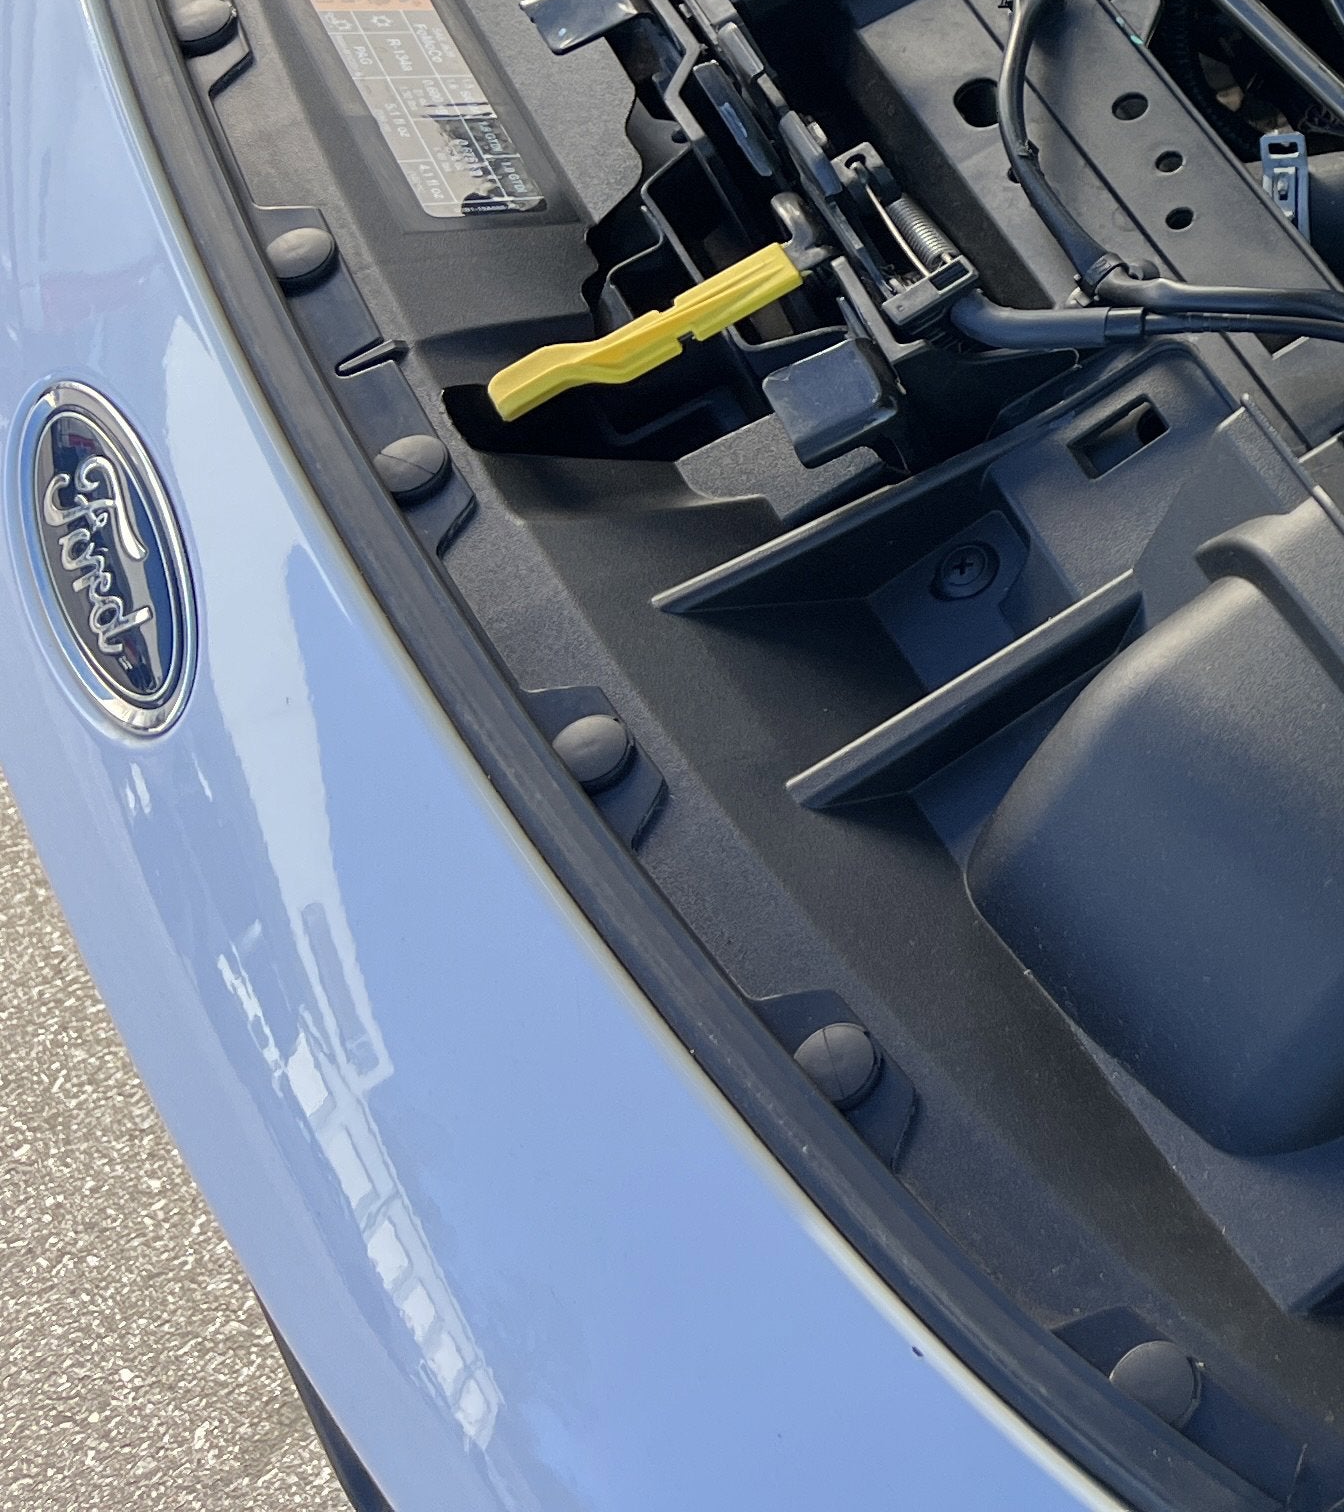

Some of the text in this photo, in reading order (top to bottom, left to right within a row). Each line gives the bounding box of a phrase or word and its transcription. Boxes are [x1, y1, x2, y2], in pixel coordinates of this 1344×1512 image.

[385, 38, 417, 71] R-134a
[383, 103, 401, 116] 5.1
[417, 163, 434, 177] 4.1
